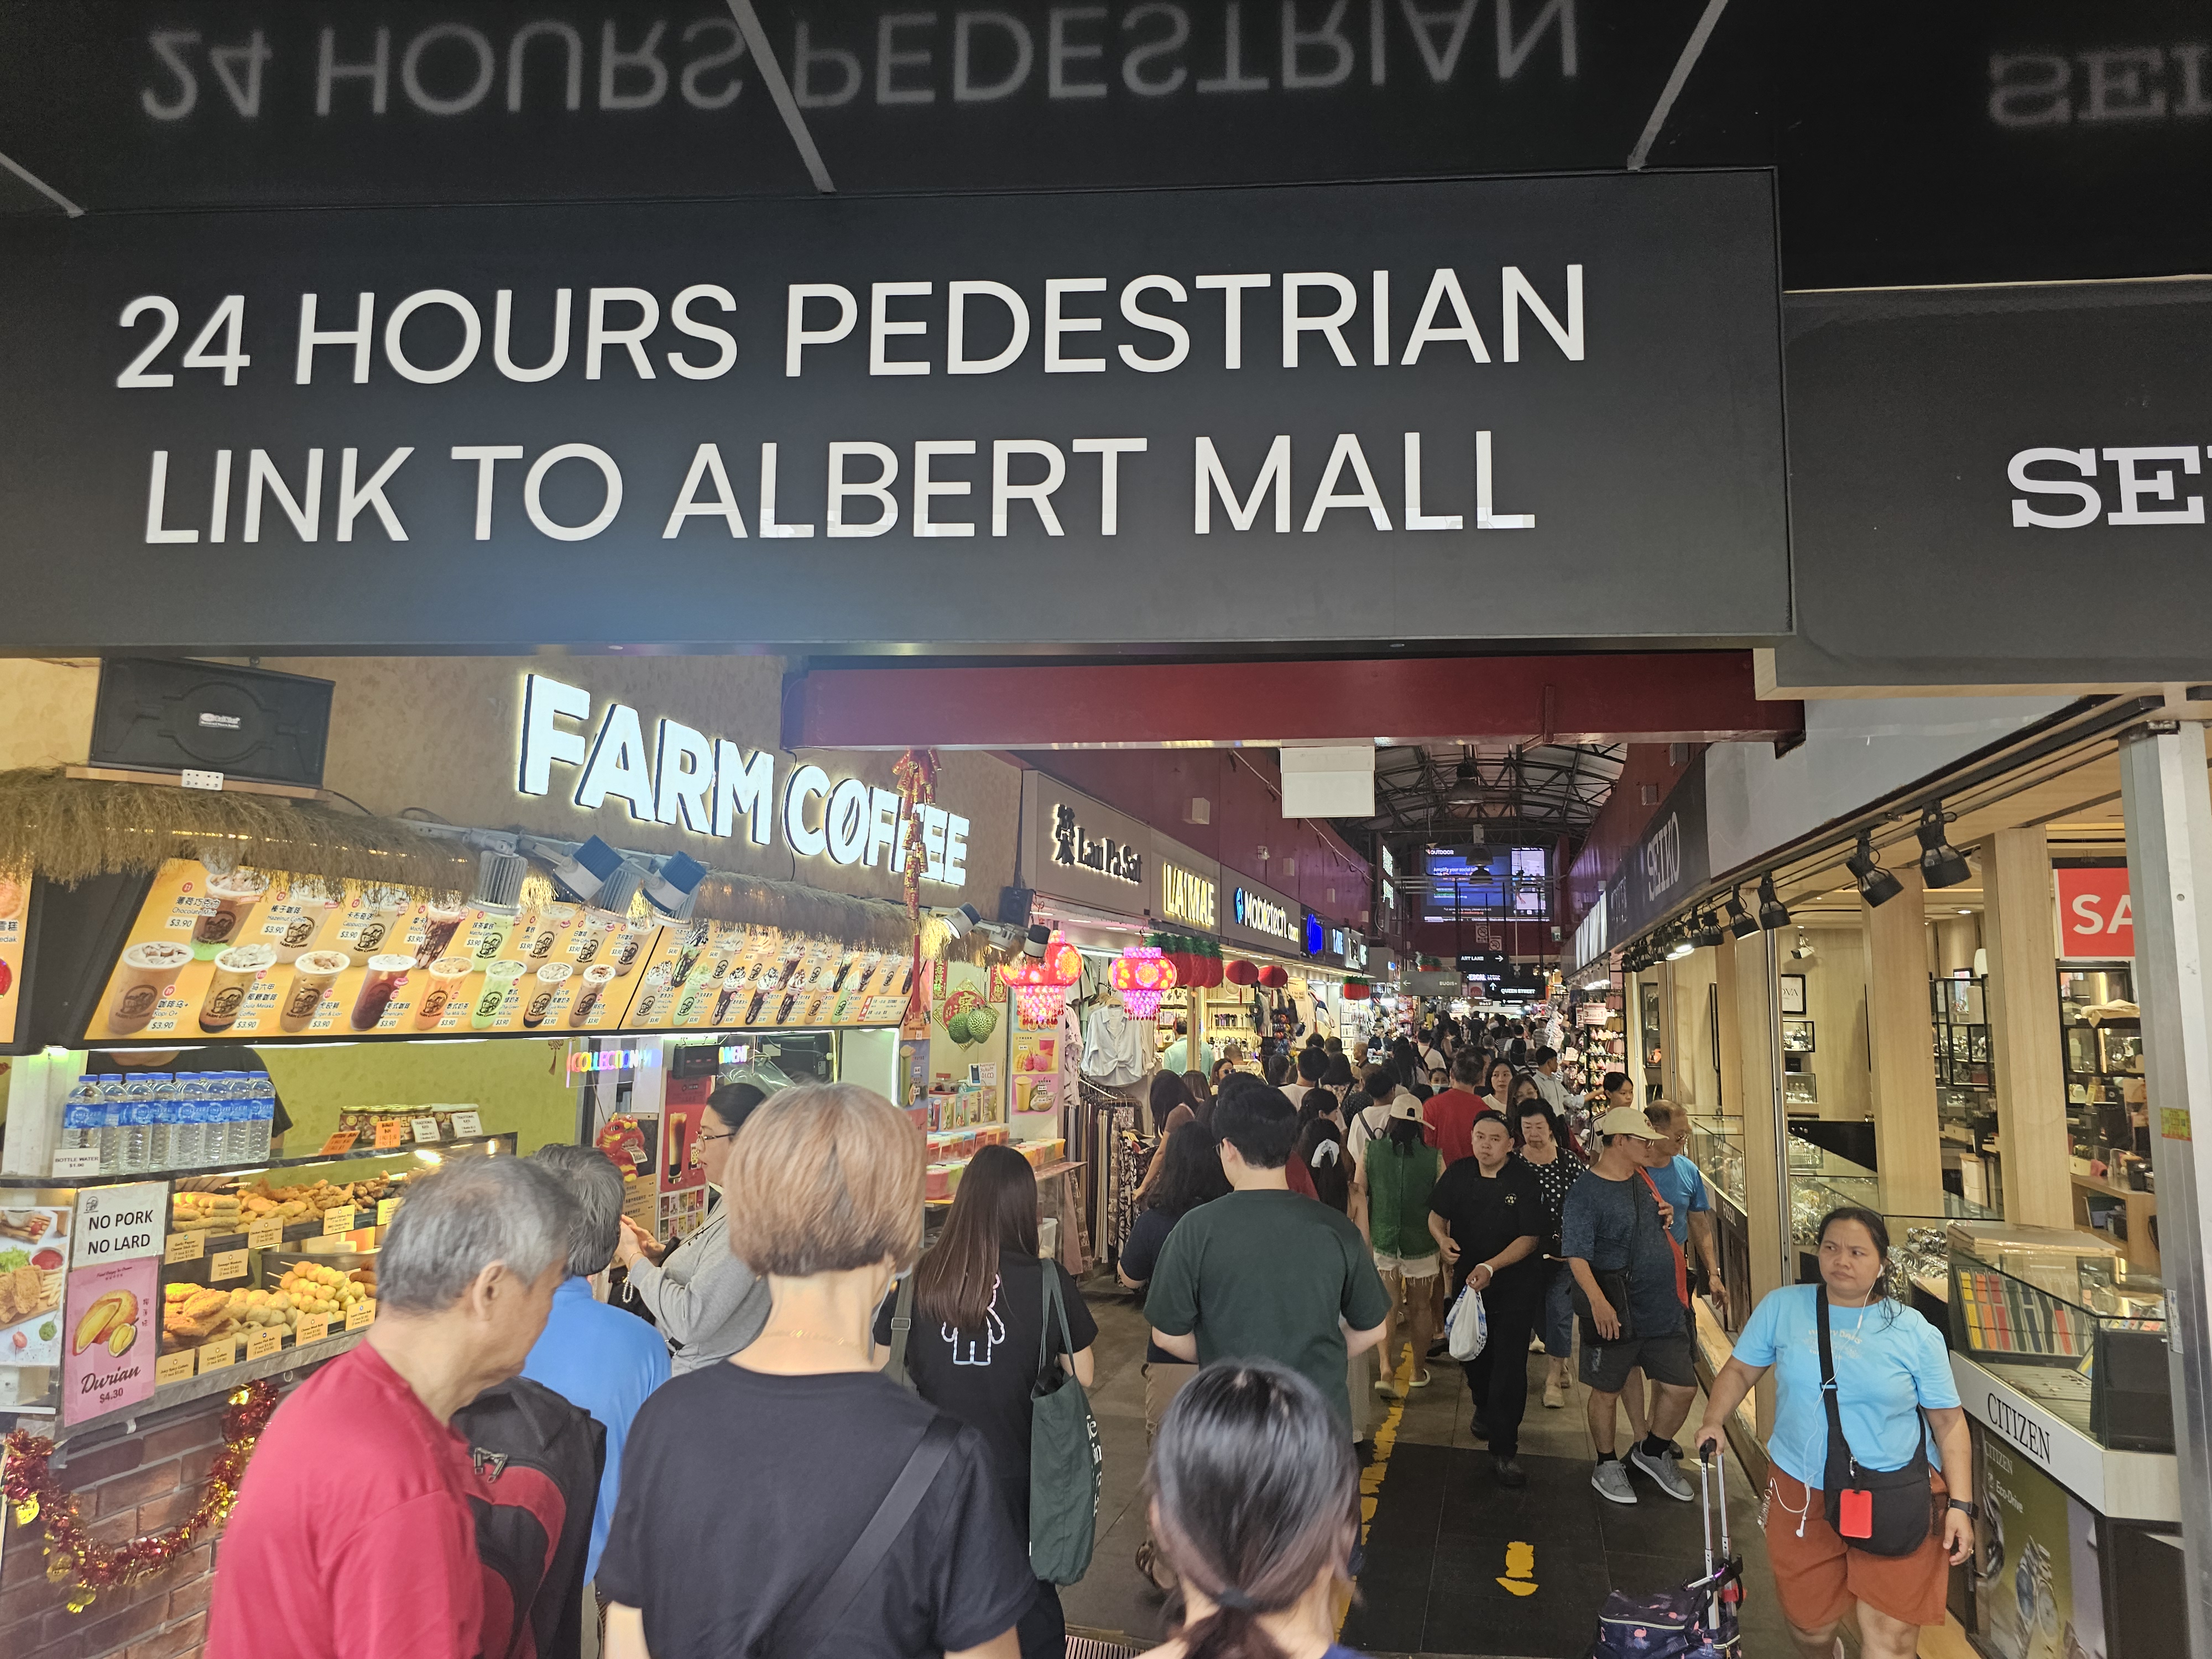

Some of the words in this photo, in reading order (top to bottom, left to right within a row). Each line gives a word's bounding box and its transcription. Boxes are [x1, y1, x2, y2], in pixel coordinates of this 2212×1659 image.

[118, 295, 250, 388] 24
[296, 284, 737, 384] HOURS
[786, 265, 1584, 377] PEDESTRIAN
[147, 447, 414, 543] LINK
[452, 444, 622, 540] TO
[662, 438, 1147, 539] ALBERT
[1195, 431, 1535, 534] MALL
[2008, 446, 2212, 528] SE
[519, 674, 774, 846] FARM
[782, 765, 970, 886] COFFEE
[1647, 811, 1679, 901] SEIKO
[172, 907, 201, 915] Chocolate
[264, 925, 284, 933] $3.90
[571, 1050, 639, 1072] COLLECTION
[89, 1215, 111, 1230] NO
[115, 1210, 153, 1227] PORK
[88, 1239, 110, 1255] NO
[114, 1234, 150, 1251] LARD
[81, 1365, 141, 1395] Durian
[100, 1387, 124, 1404] $4.30
[1987, 1392, 2051, 1464] CITIZEN
[1985, 1441, 2013, 1475] CITIZEN
[1996, 1479, 2025, 1514] Eco-Drive
